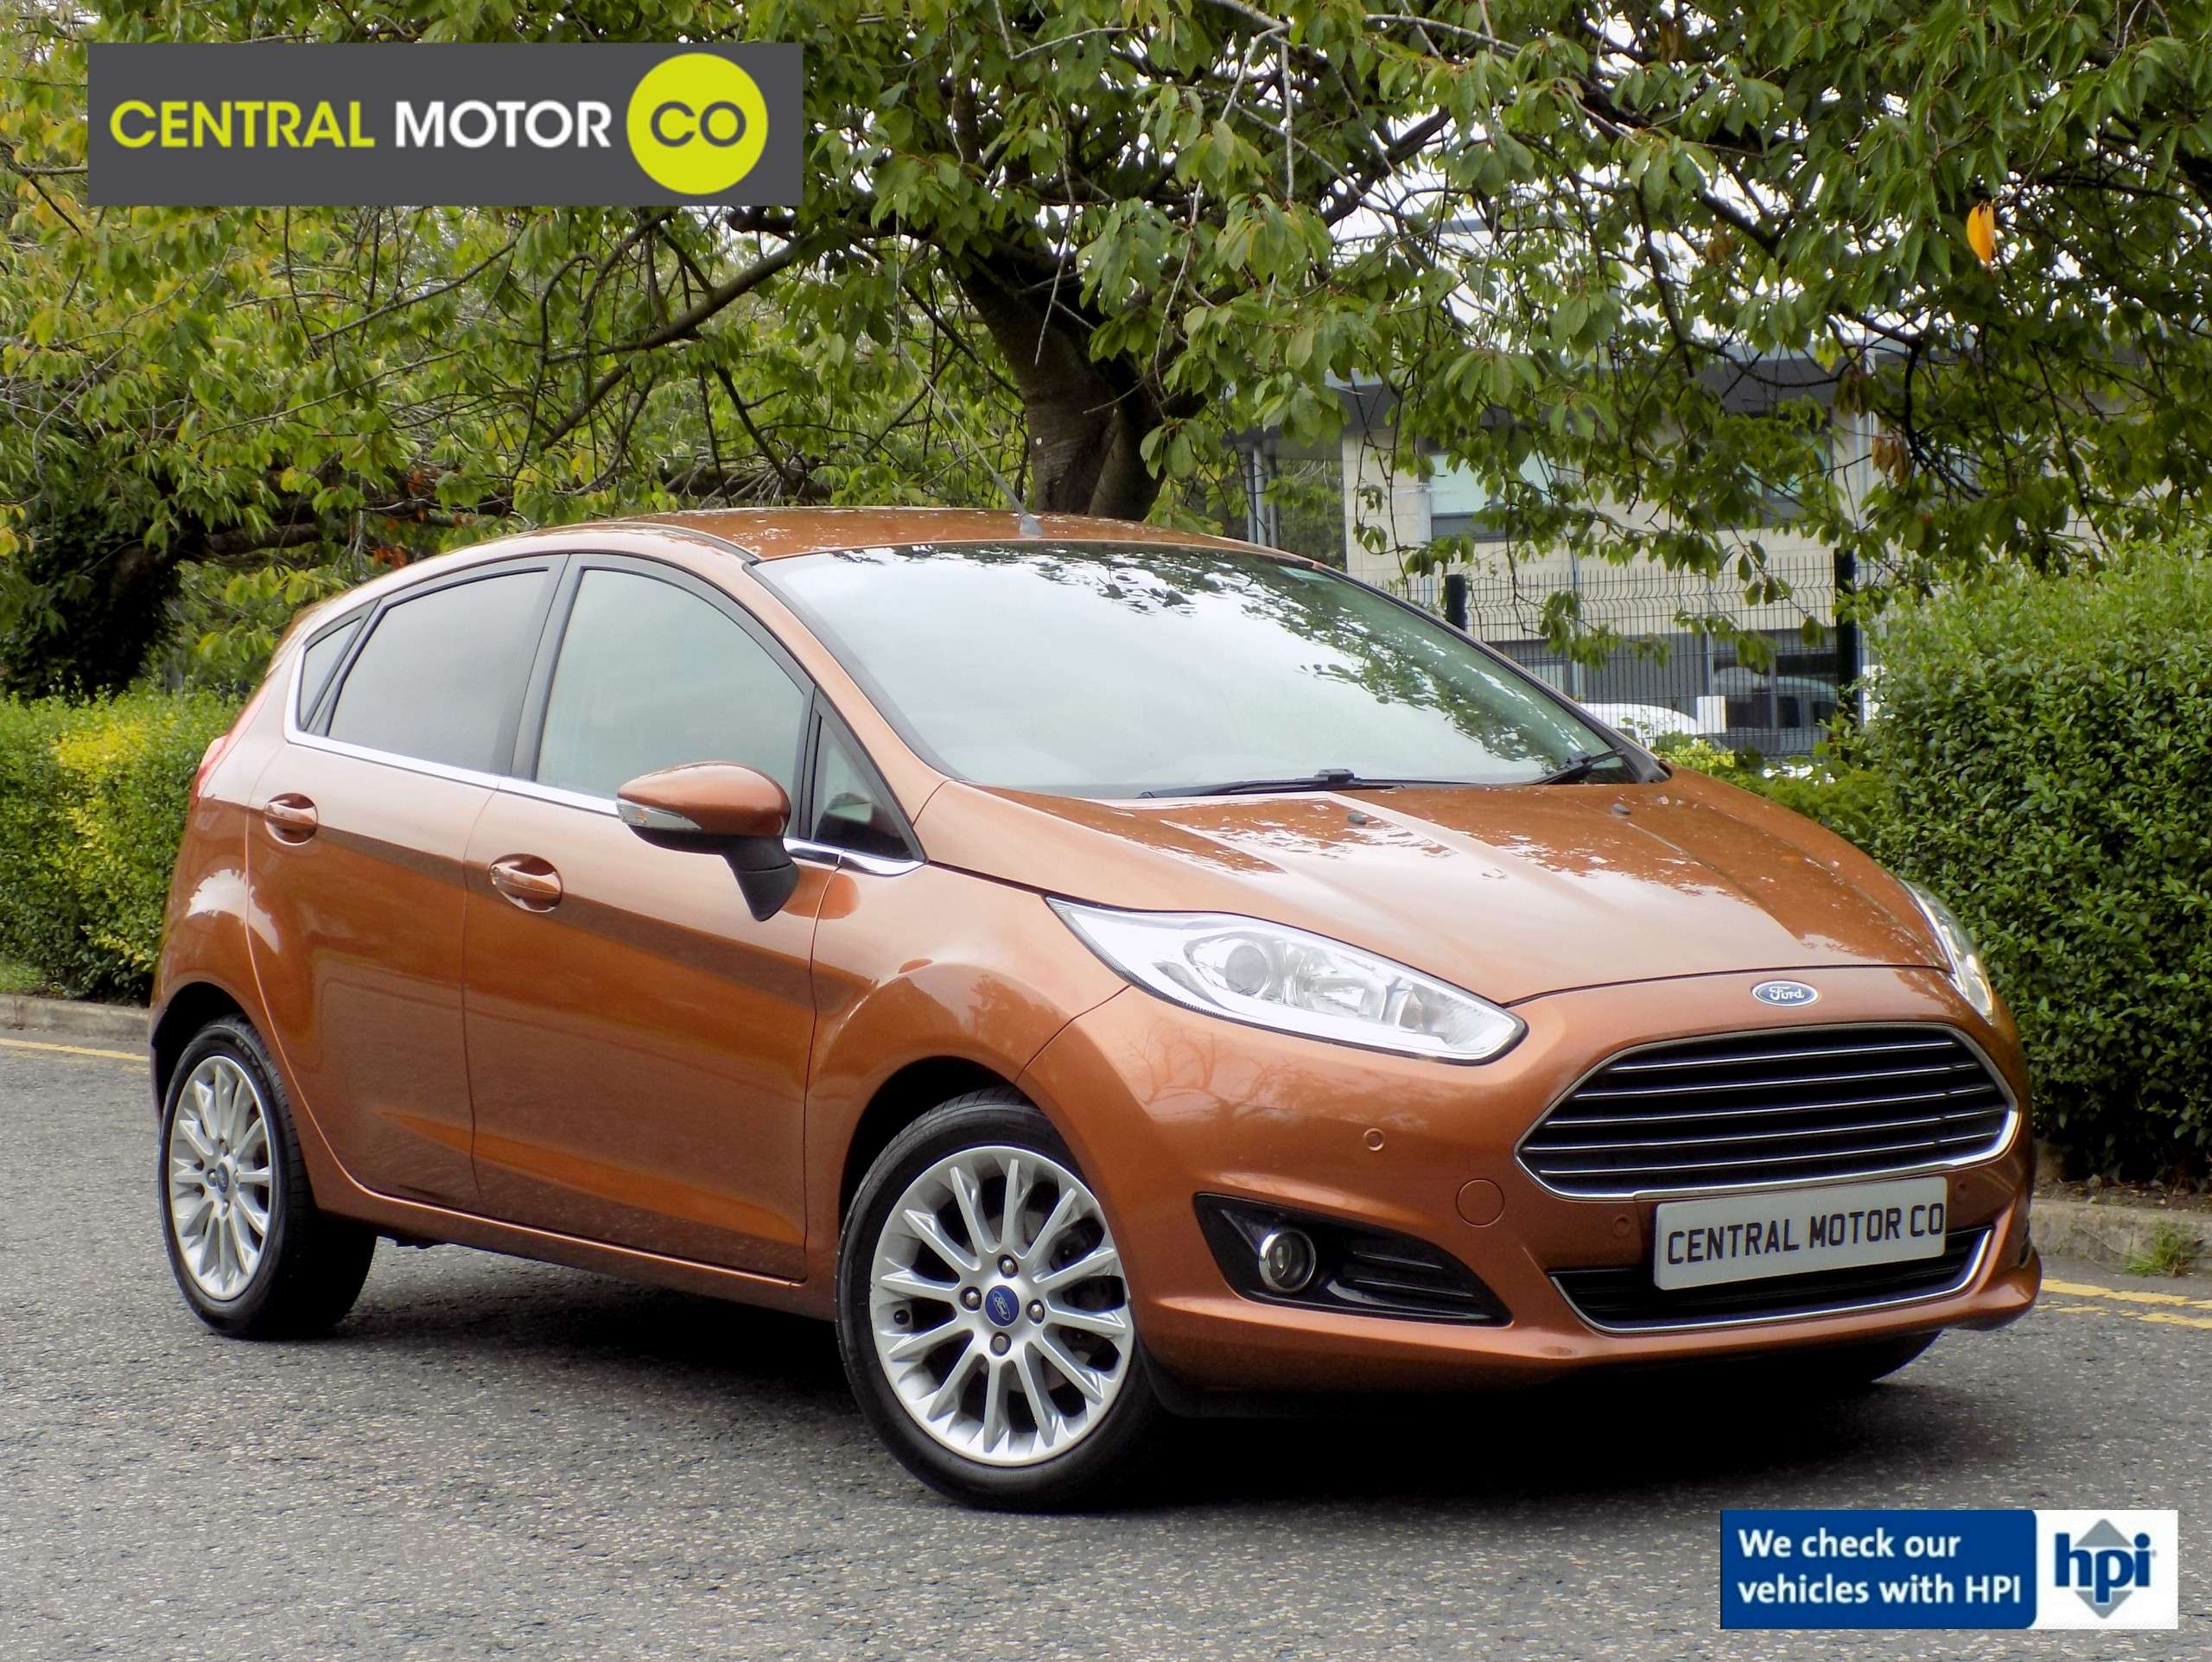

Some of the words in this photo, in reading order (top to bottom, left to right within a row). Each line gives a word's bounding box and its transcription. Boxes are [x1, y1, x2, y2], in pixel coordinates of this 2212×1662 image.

[1769, 986, 1805, 1001] Ford
[1667, 1219, 1800, 1266] CENTRAL
[1809, 1207, 1902, 1249] MOTOR
[1910, 1202, 1944, 1238] CO
